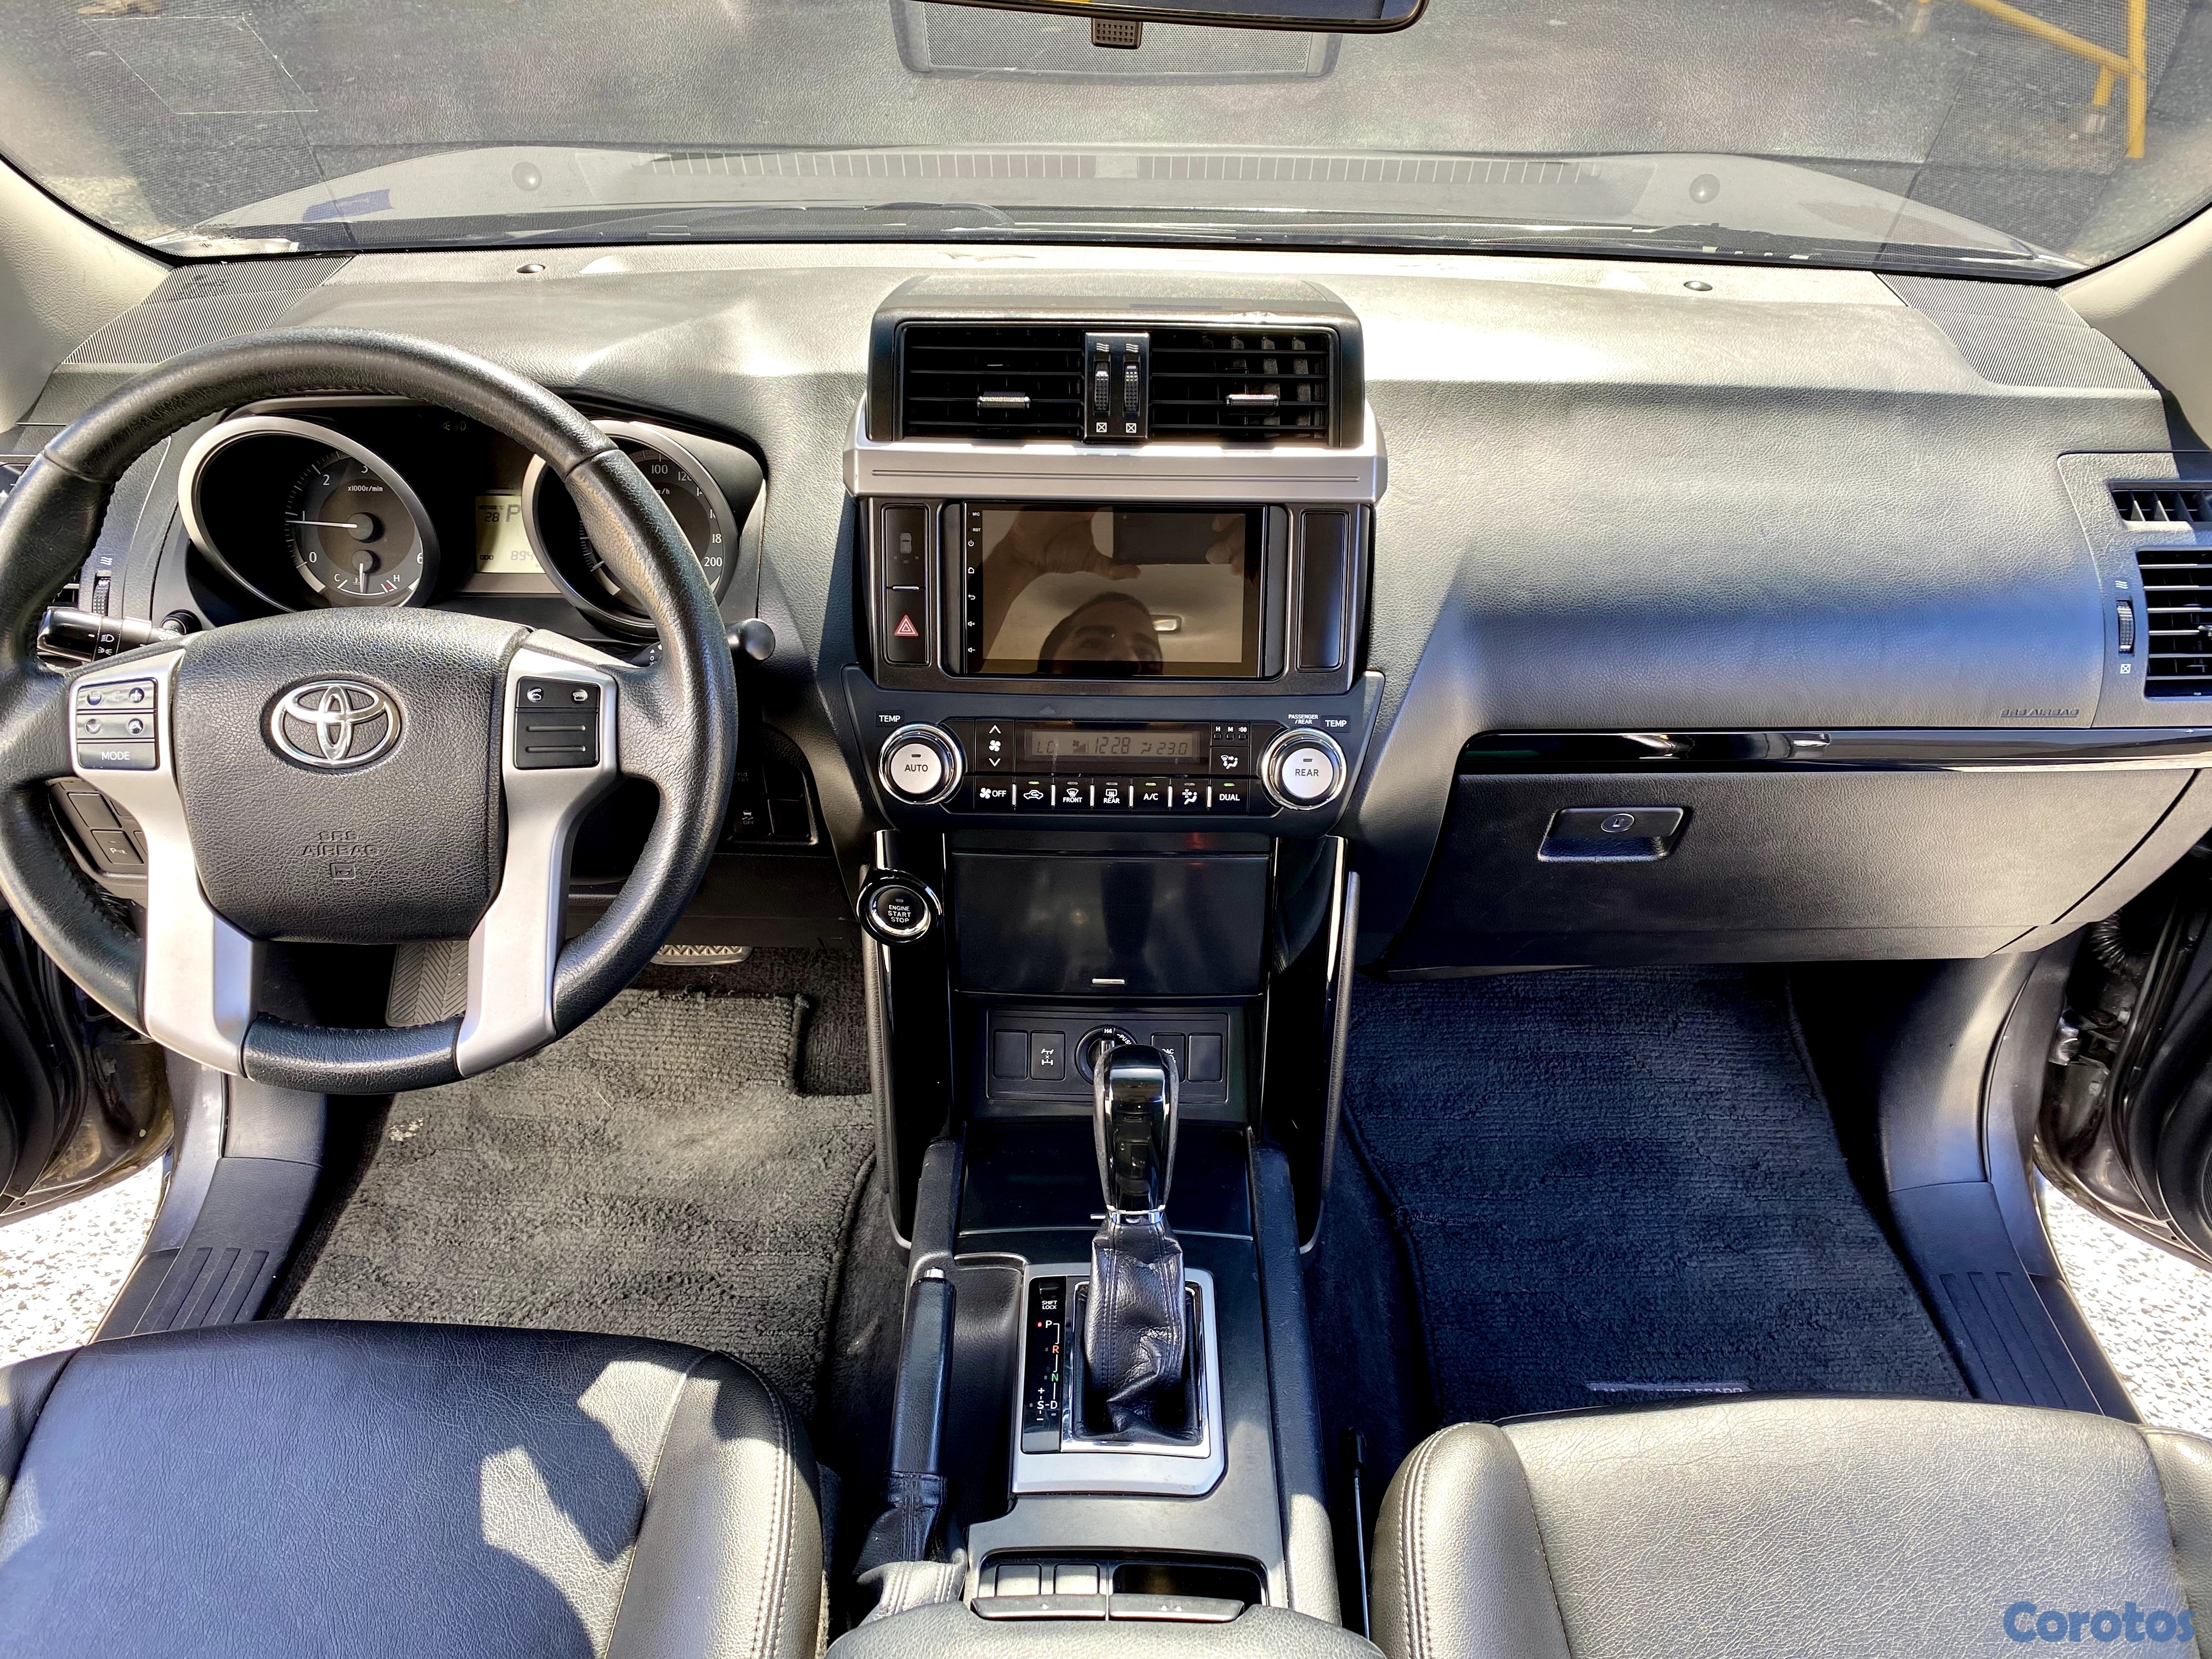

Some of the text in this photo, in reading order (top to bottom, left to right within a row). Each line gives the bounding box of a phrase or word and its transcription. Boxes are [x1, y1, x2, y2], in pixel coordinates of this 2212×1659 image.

[651, 465, 668, 474] 100
[323, 475, 330, 486] 2
[484, 512, 500, 522] 28
[505, 504, 521, 522] P
[712, 534, 722, 544] 18
[309, 551, 317, 563] 0
[416, 552, 423, 564] 6
[704, 557, 723, 567] 200
[334, 574, 340, 582] C
[1156, 742, 1188, 755] 23.0
[101, 751, 130, 760] MODE
[1295, 769, 1319, 777] REAR
[1119, 1034, 1132, 1045] PUS
[1045, 1320, 1053, 1328] P
[1052, 1345, 1059, 1353] R
[1051, 1373, 1059, 1382] N
